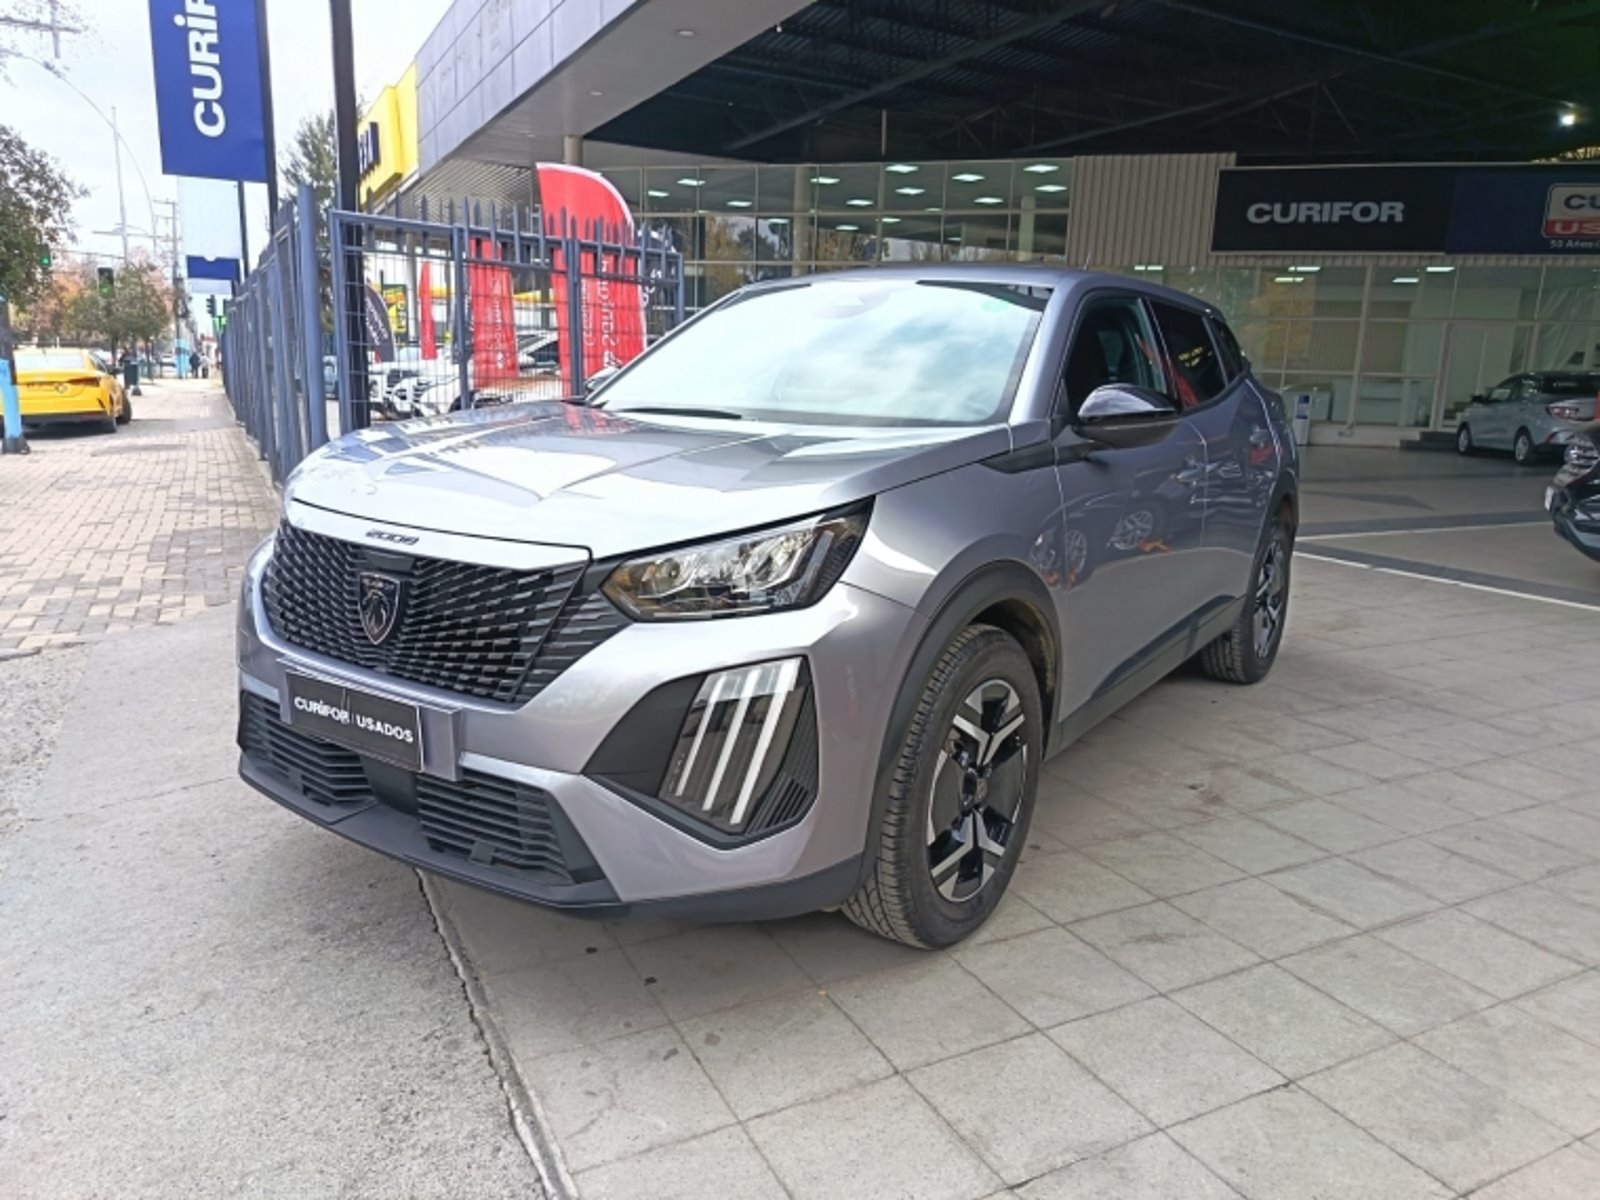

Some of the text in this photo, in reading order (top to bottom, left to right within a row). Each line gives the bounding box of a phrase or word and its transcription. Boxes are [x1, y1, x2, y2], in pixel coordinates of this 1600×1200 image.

[1246, 201, 1405, 225] CURIFOR
[365, 529, 420, 546] 2008
[355, 714, 414, 744] USADOS
